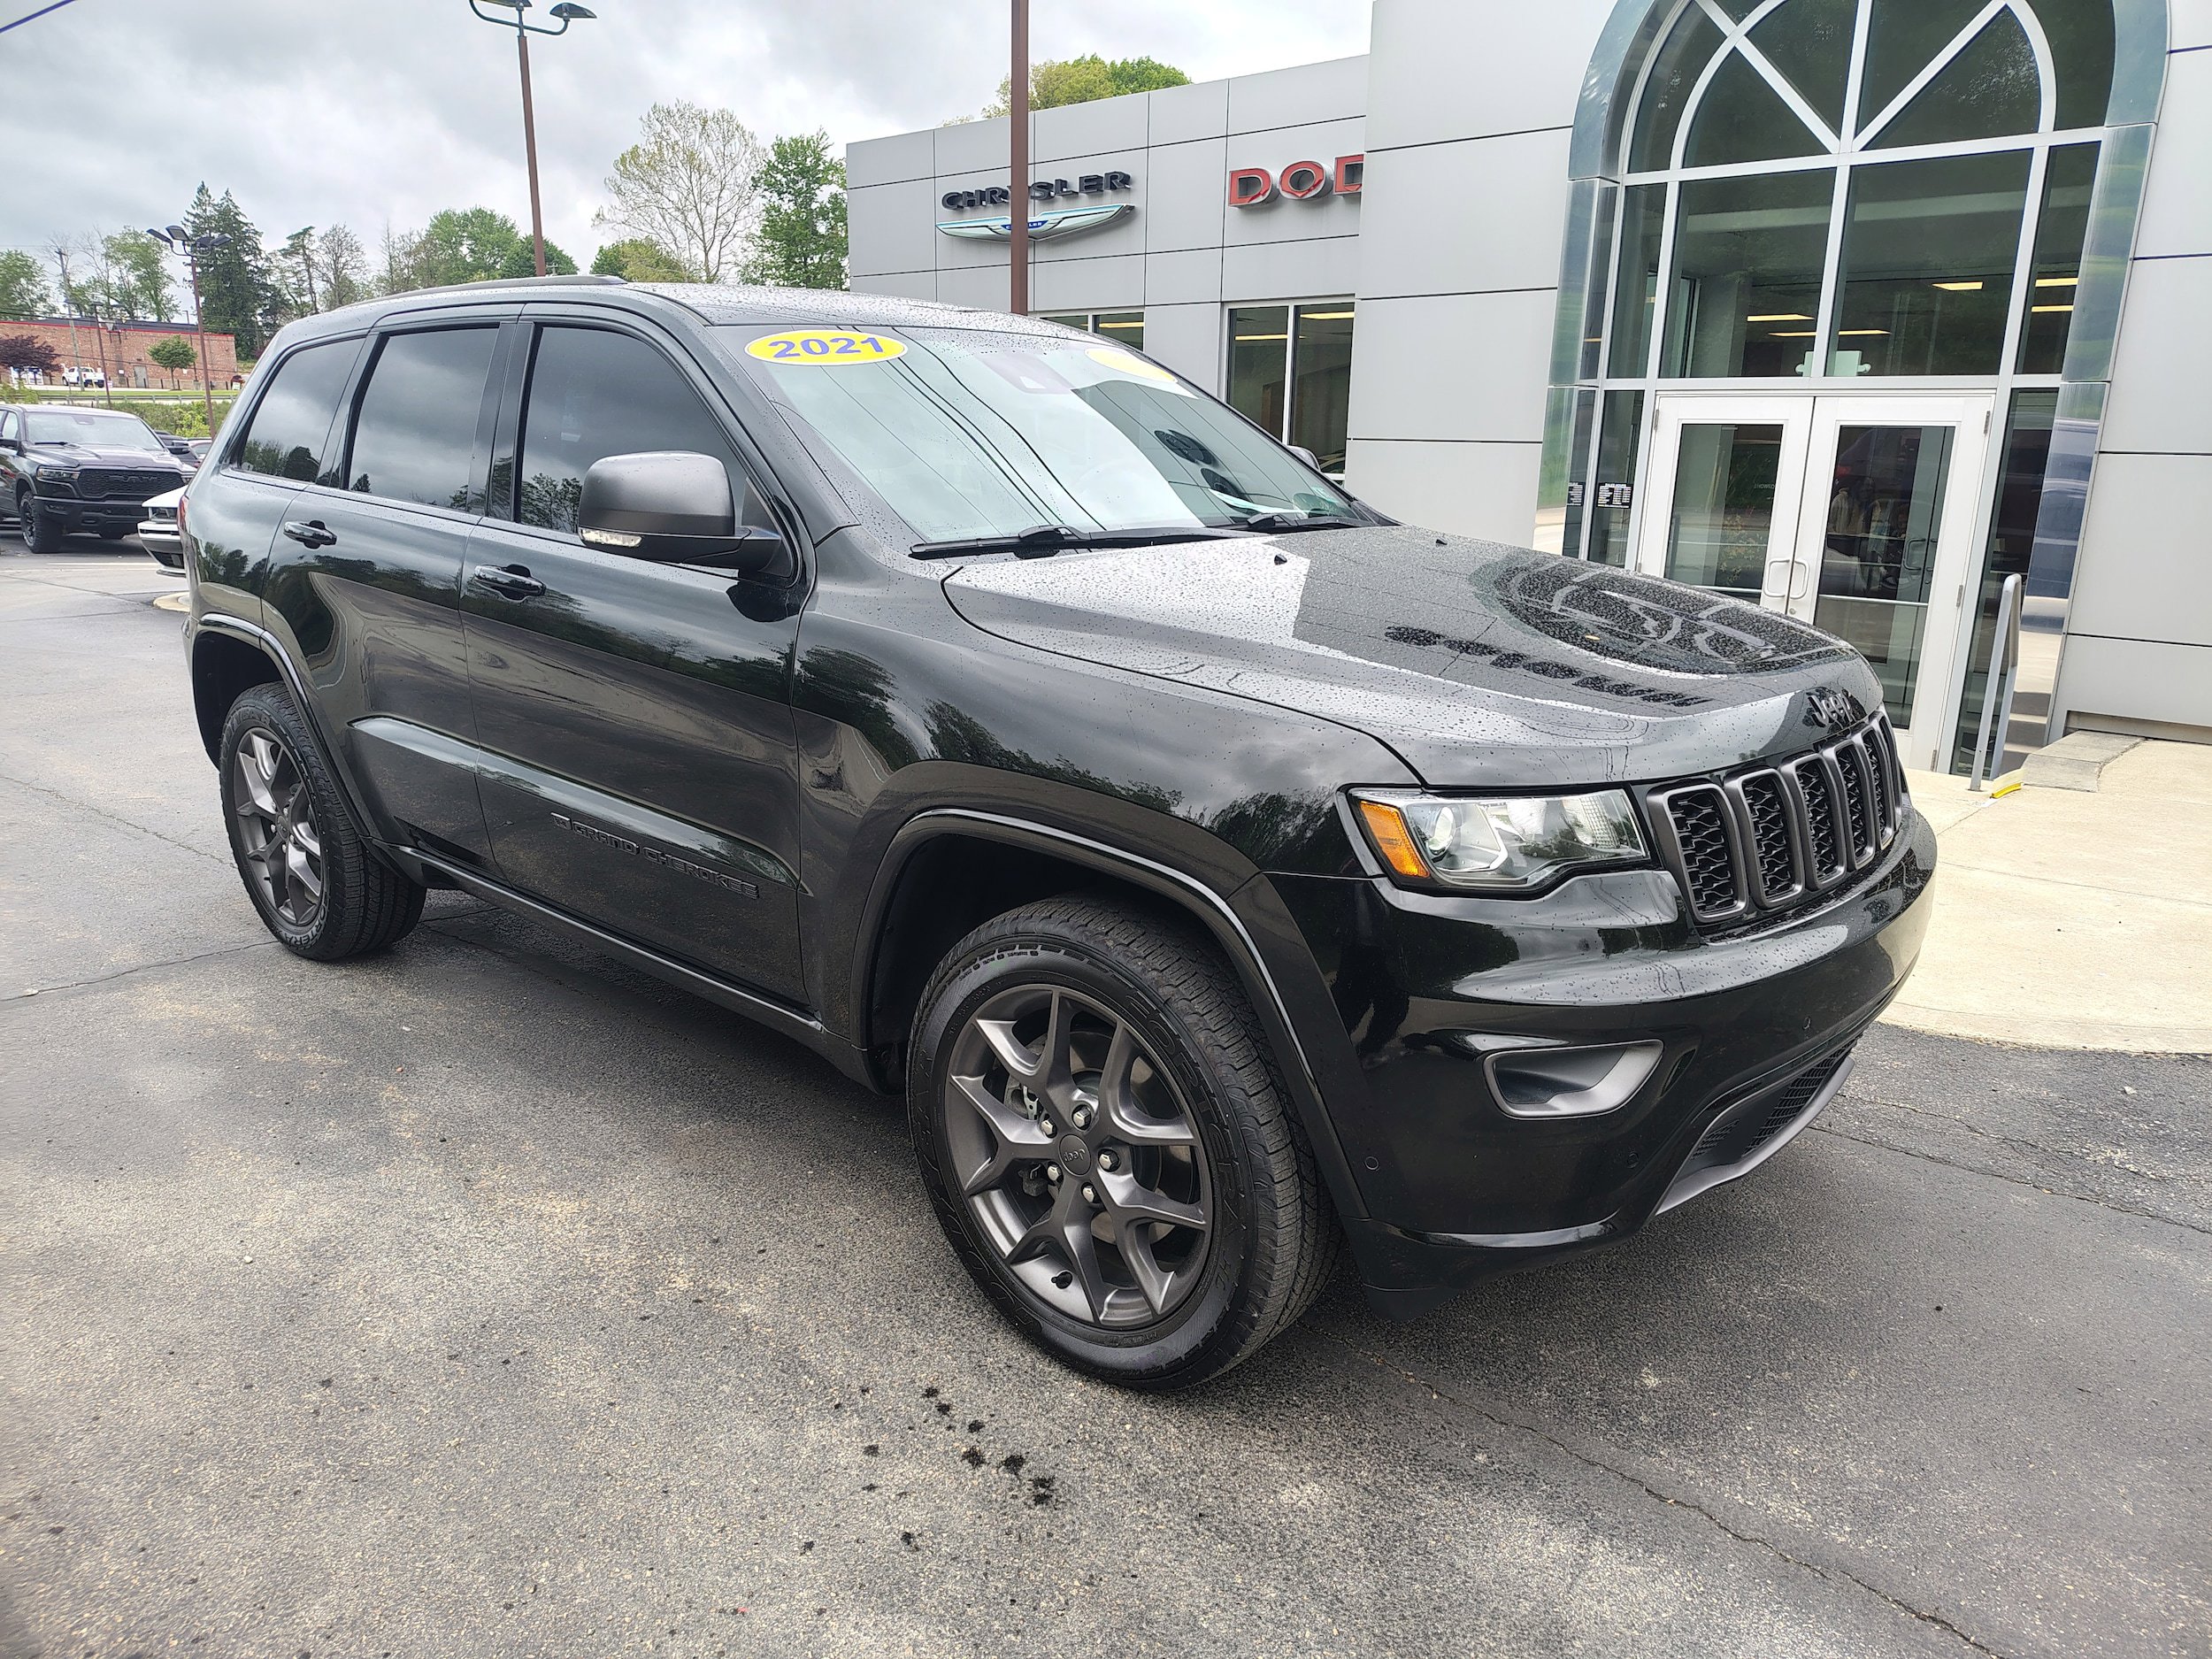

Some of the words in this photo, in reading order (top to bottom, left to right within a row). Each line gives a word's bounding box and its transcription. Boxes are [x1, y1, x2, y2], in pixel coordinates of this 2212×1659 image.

[941, 171, 1132, 211] CHRSLER
[768, 337, 884, 358] 2021
[1808, 693, 1851, 727] Jeep
[573, 822, 640, 856] GRAND
[642, 847, 760, 900] CHEROKEE
[1064, 1148, 1086, 1162] Jeep
